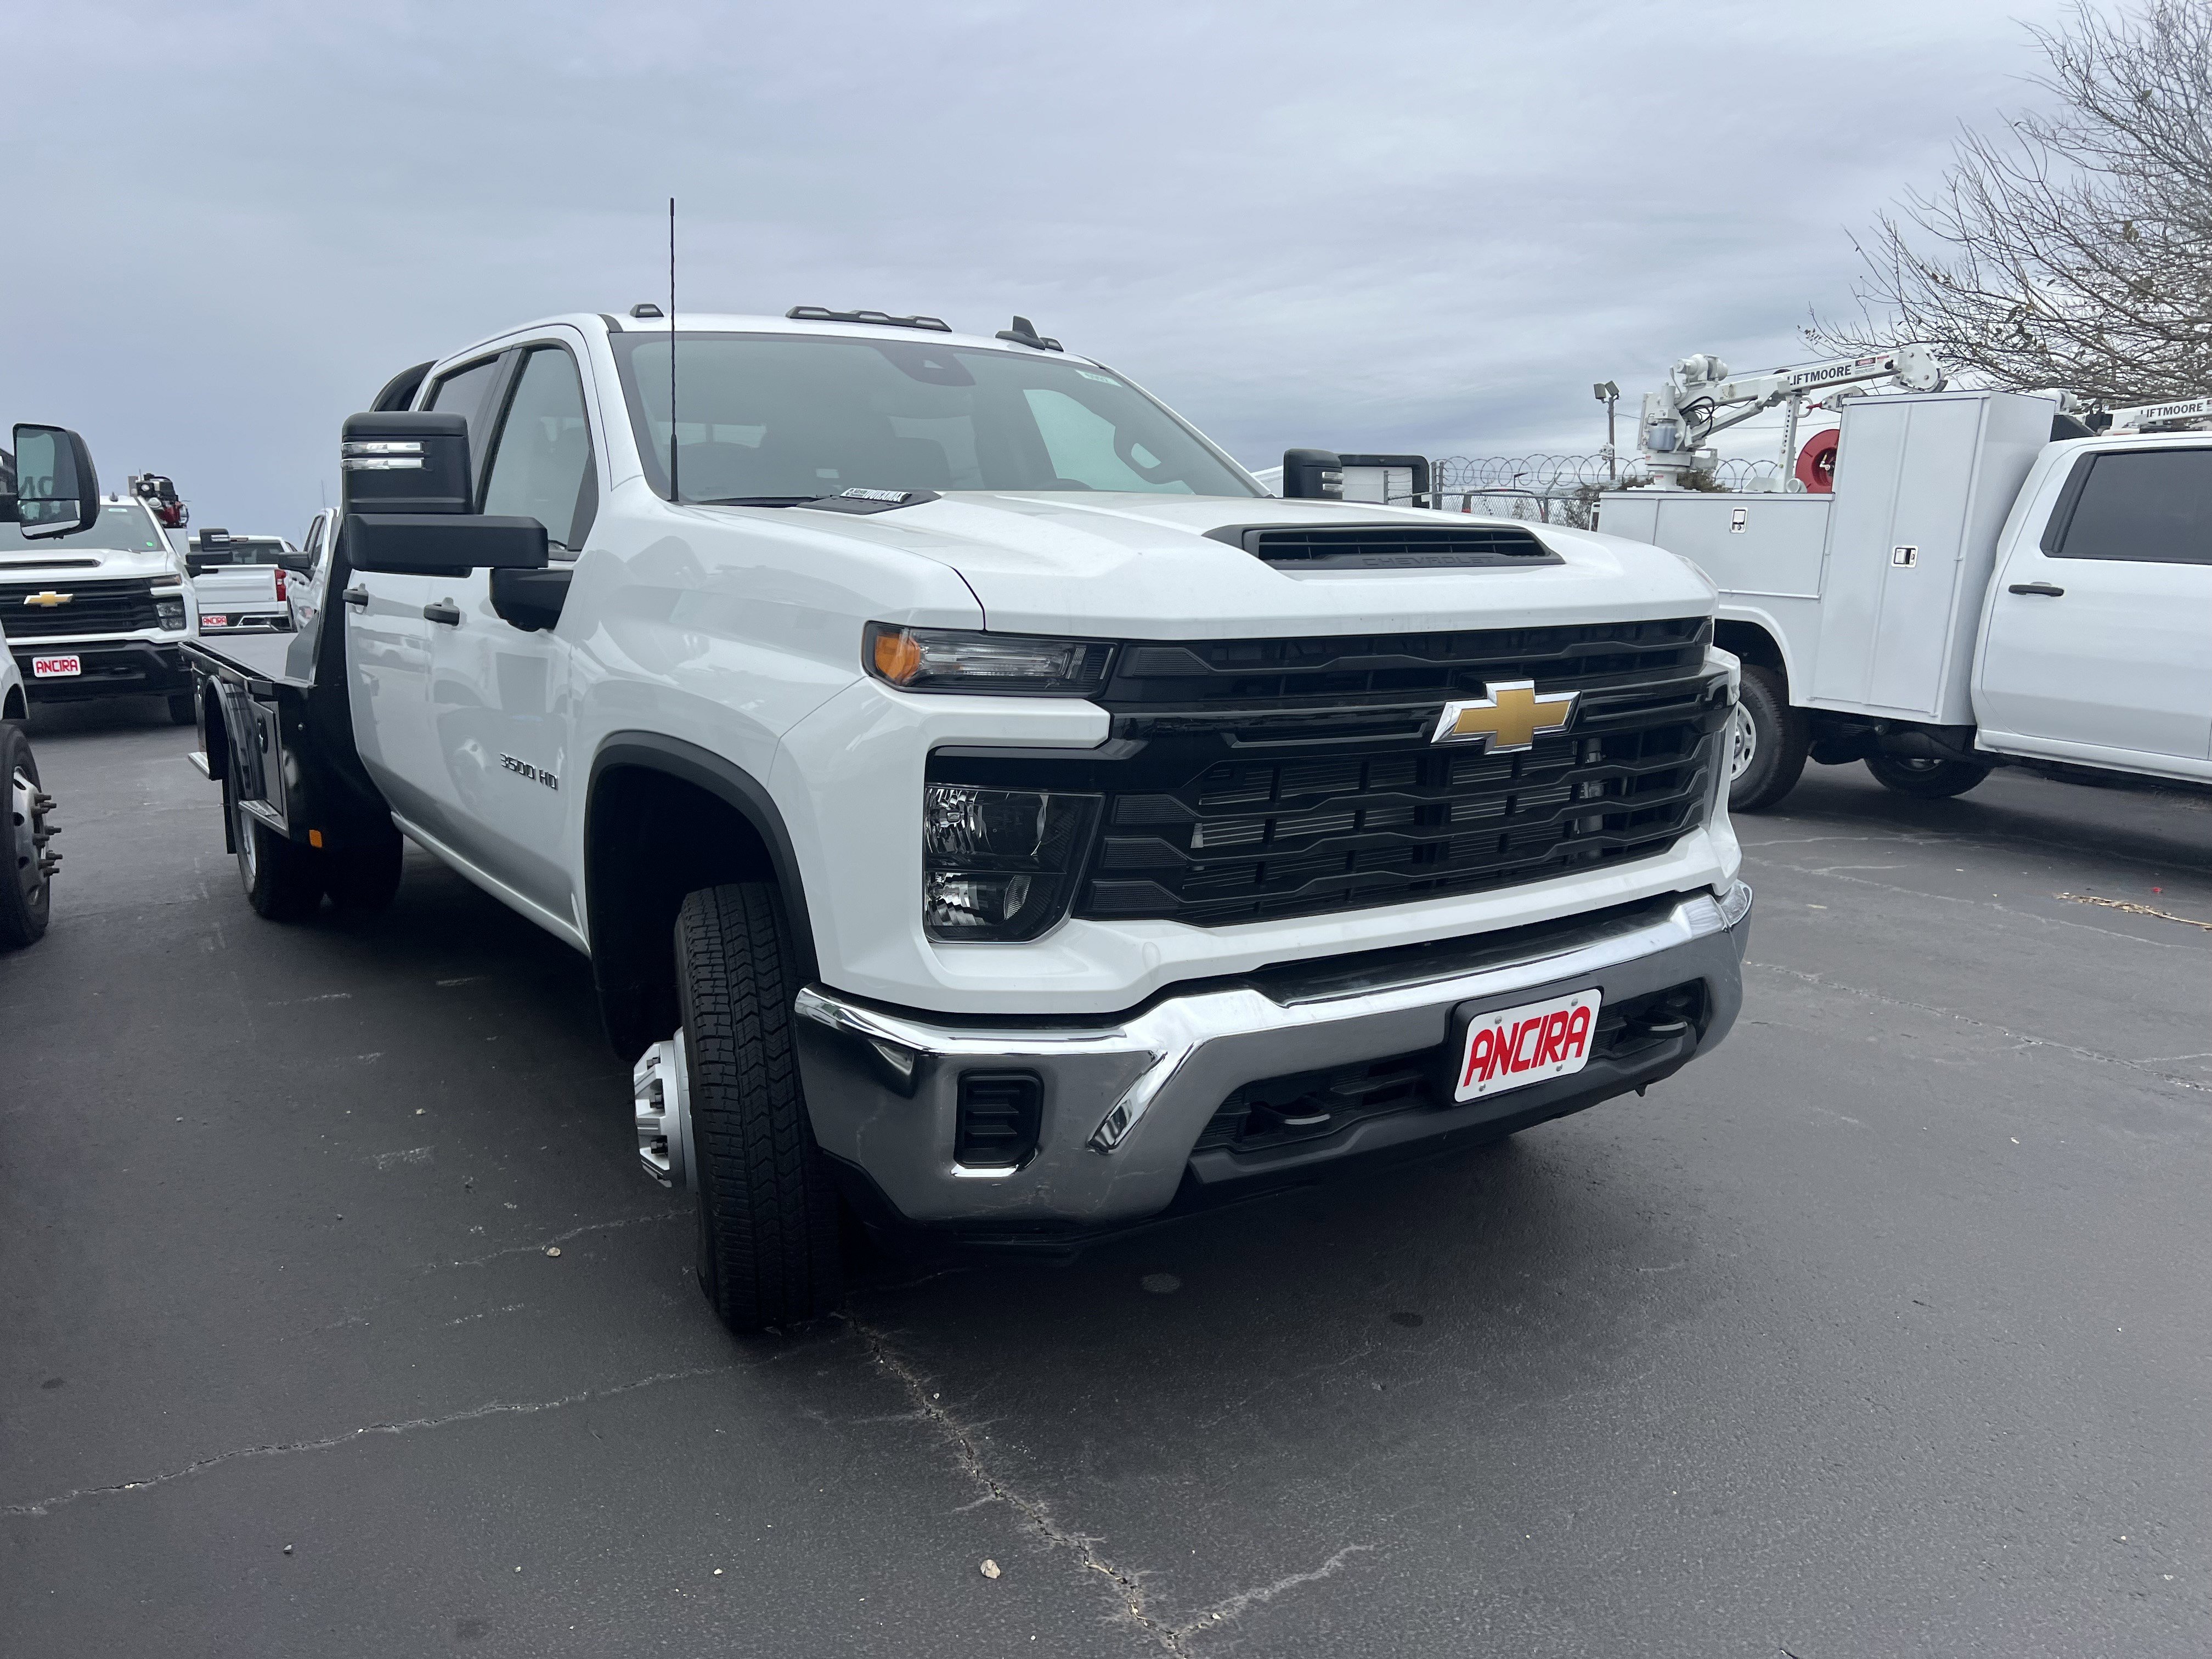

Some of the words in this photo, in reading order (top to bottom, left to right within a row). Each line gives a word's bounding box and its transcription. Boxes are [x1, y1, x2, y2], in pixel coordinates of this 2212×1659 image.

[1362, 556, 1493, 566] CHEVROLET
[36, 659, 78, 673] ANCIRA
[500, 752, 537, 780] 3500
[539, 769, 559, 790] HD
[1463, 1006, 1590, 1087] ANCIRA
